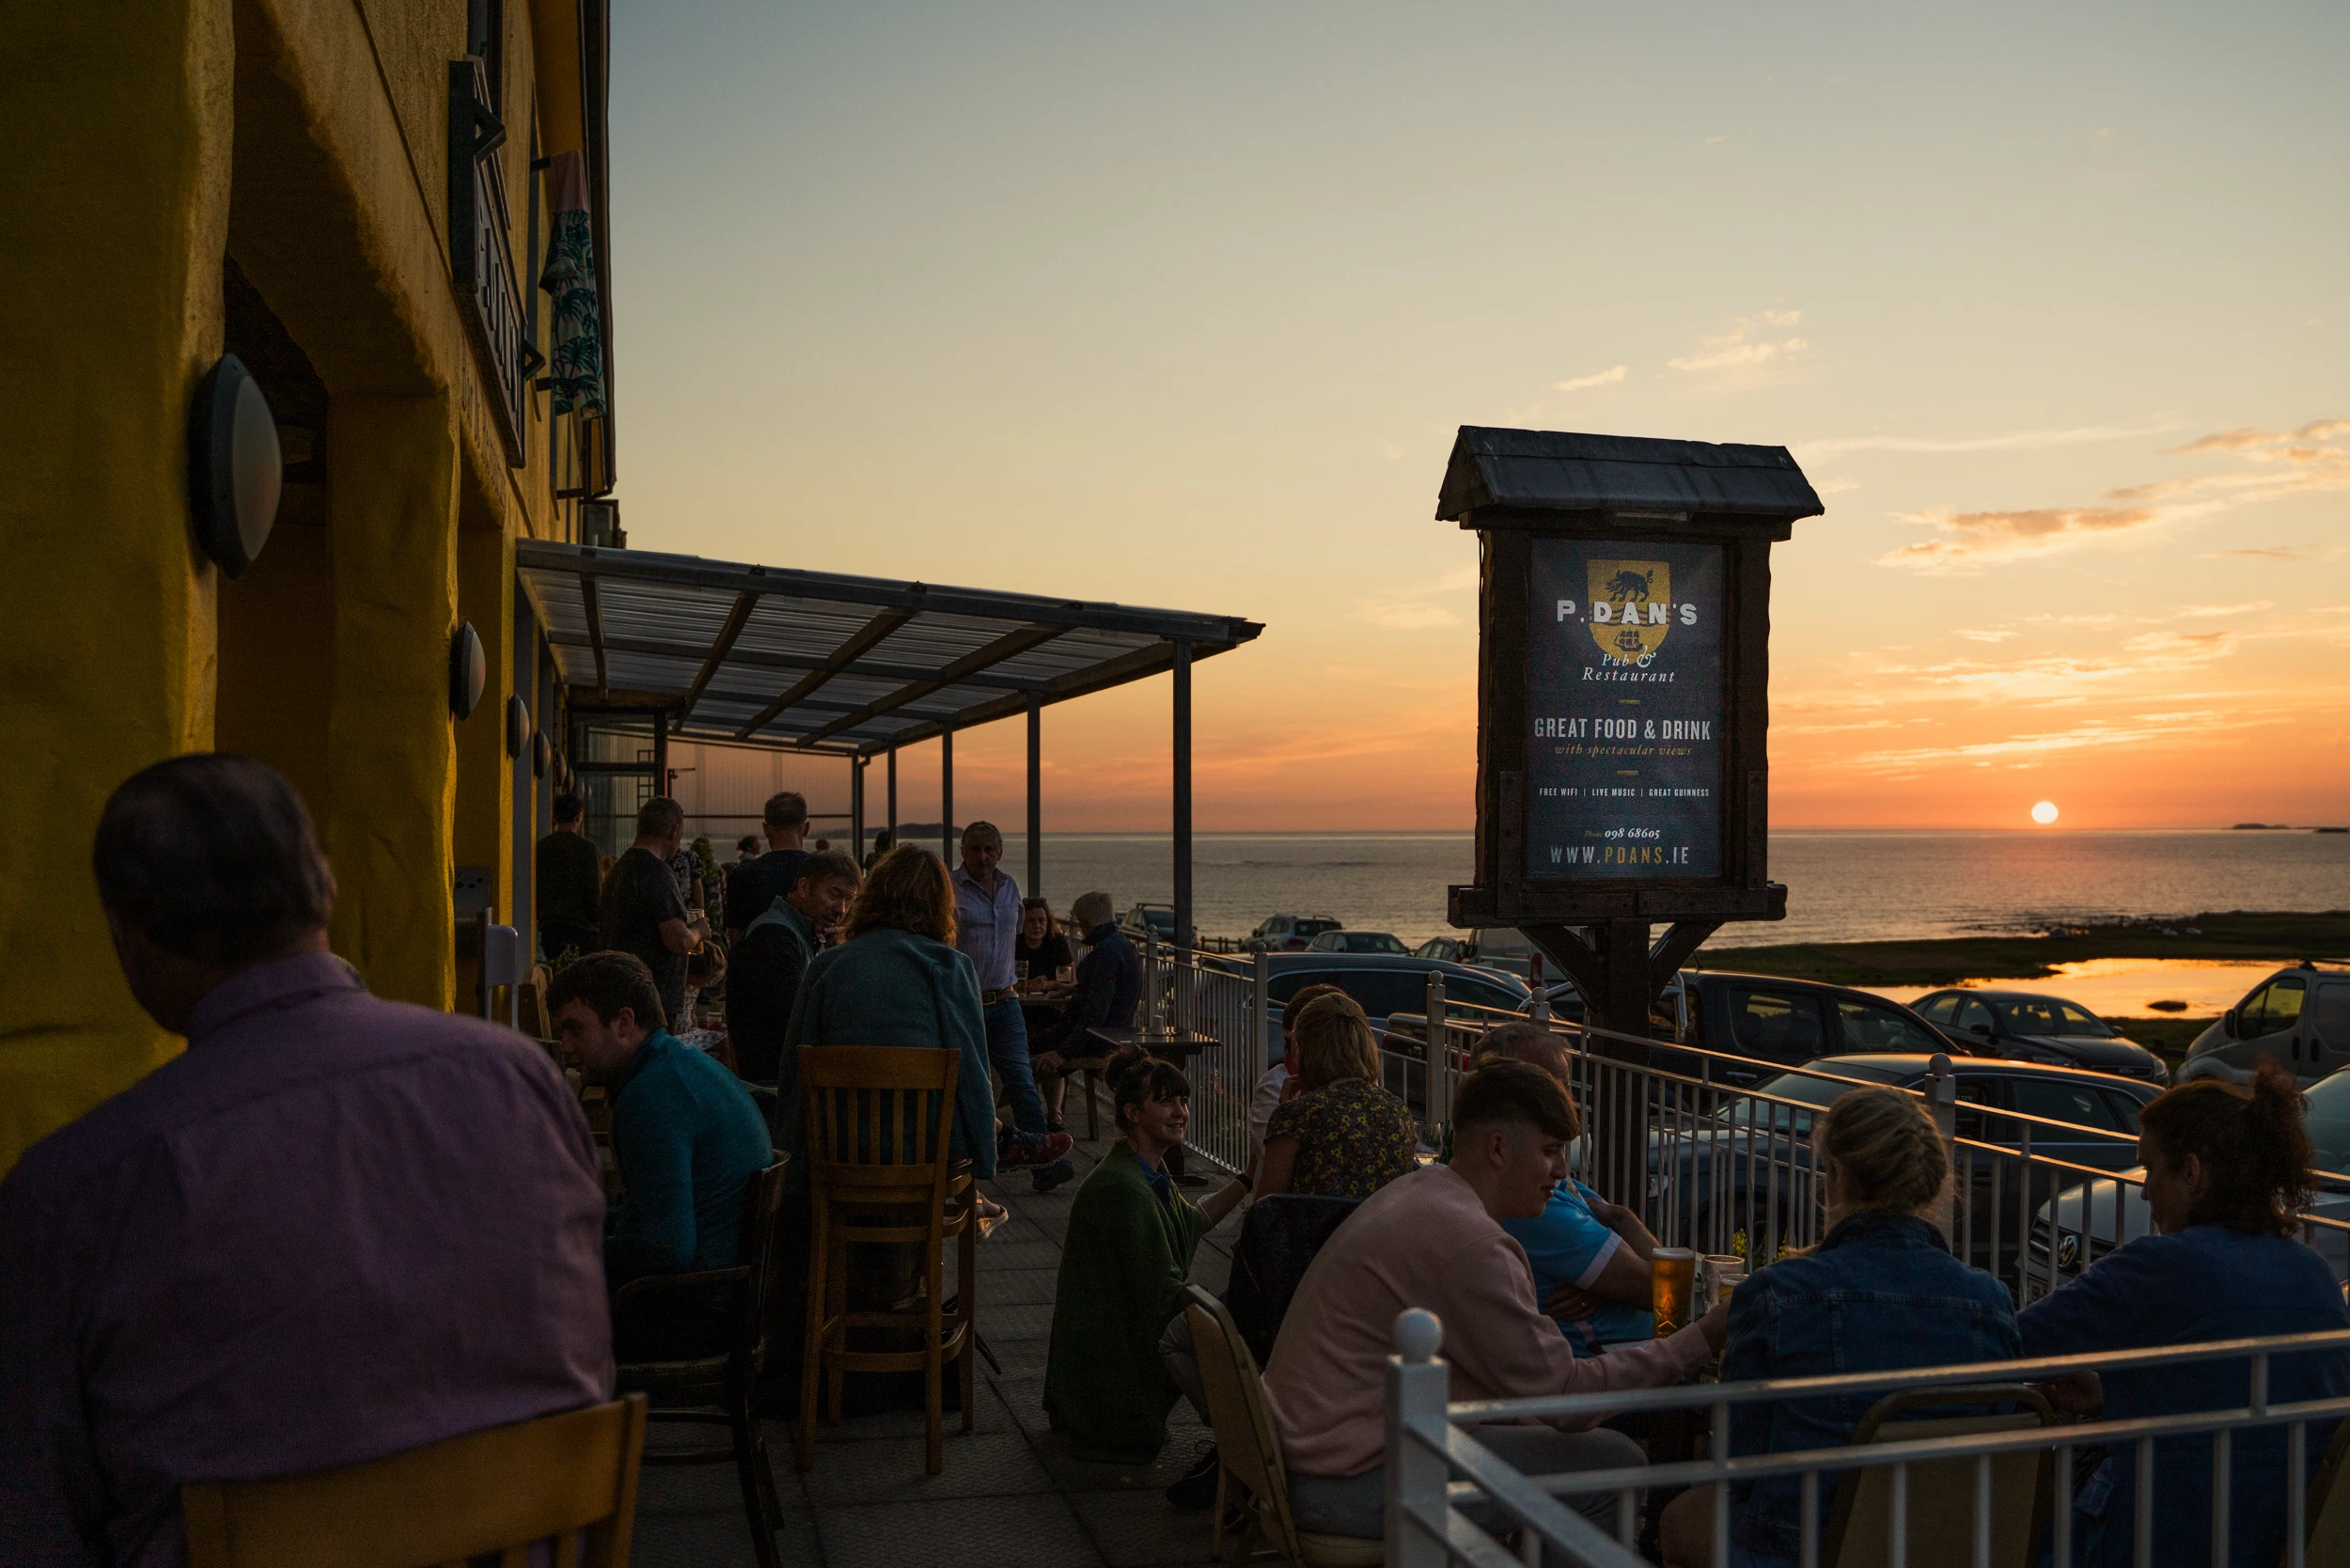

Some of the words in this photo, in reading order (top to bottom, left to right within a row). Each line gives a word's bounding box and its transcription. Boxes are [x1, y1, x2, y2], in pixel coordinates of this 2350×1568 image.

[1557, 600, 1698, 626] P.DAN'S
[1601, 653, 1630, 667] Pub
[1637, 644, 1657, 668] &
[1582, 666, 1676, 682] Restaurant
[1534, 717, 1588, 739] GREAT
[1594, 718, 1637, 740] FOOD
[1644, 719, 1656, 740] &
[1662, 720, 1711, 741] DRINK
[1554, 744, 1583, 756] with
[1587, 744, 1654, 759] spectacular
[1659, 746, 1692, 756] views
[1539, 788, 1558, 796] FREE
[1560, 788, 1578, 796] WIFI
[1591, 788, 1608, 796] LIVE
[1611, 788, 1636, 797] MUSIC
[1649, 788, 1671, 797] GREAT
[1674, 788, 1710, 797] GUINNESS
[1604, 827, 1625, 840] 098
[1627, 827, 1661, 840] 68605
[1550, 845, 1690, 865] WWW.PDANS.IE
